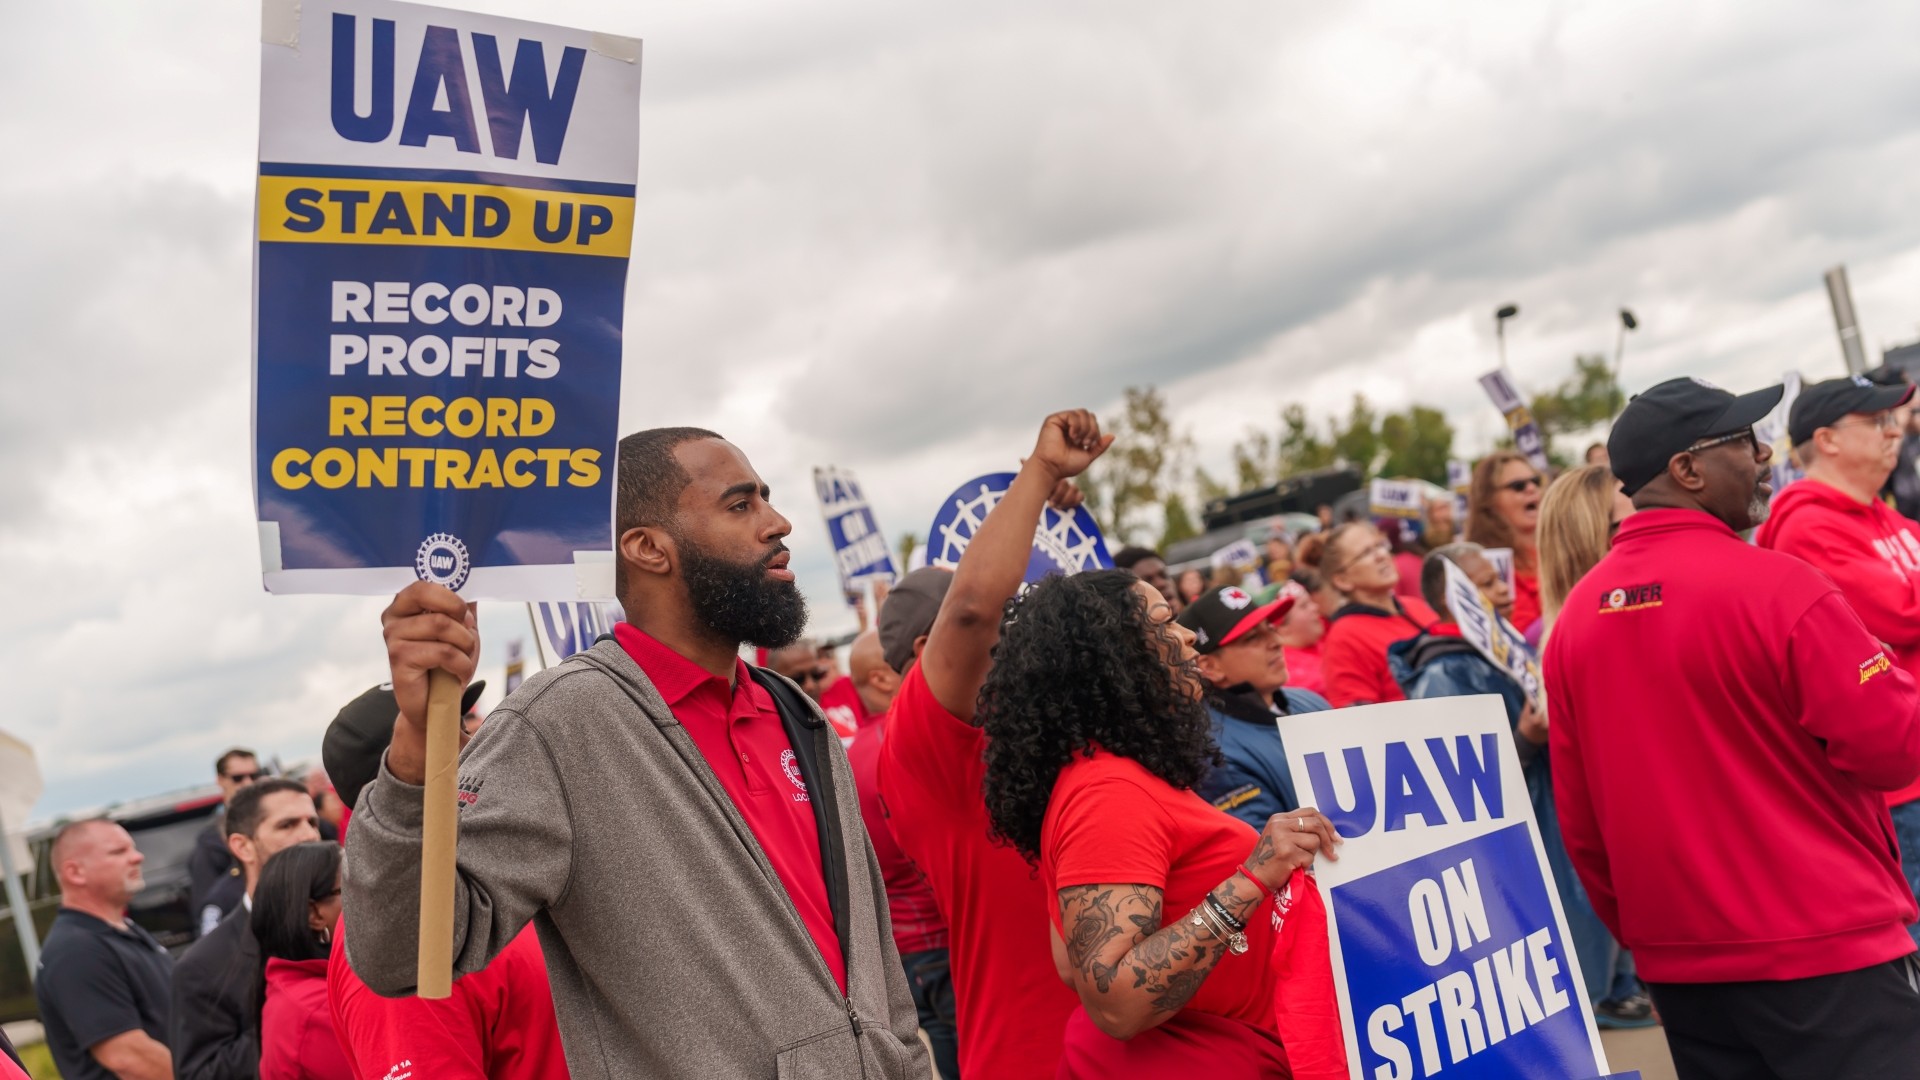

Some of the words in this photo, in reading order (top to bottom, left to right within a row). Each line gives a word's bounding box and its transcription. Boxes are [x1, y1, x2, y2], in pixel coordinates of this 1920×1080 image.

[331, 13, 587, 165] UAW
[283, 187, 511, 239] STAND
[532, 200, 613, 246] UP
[331, 280, 563, 327] RECORD
[329, 334, 561, 379] PROFITS
[329, 395, 556, 438] RECORD
[271, 447, 601, 490] CONTRACTS
[430, 554, 455, 570] UAW
[1600, 583, 1663, 609] POWER
[1303, 733, 1504, 839] UAW
[1408, 857, 1491, 968] ON
[1367, 926, 1571, 1080] STRIKE
